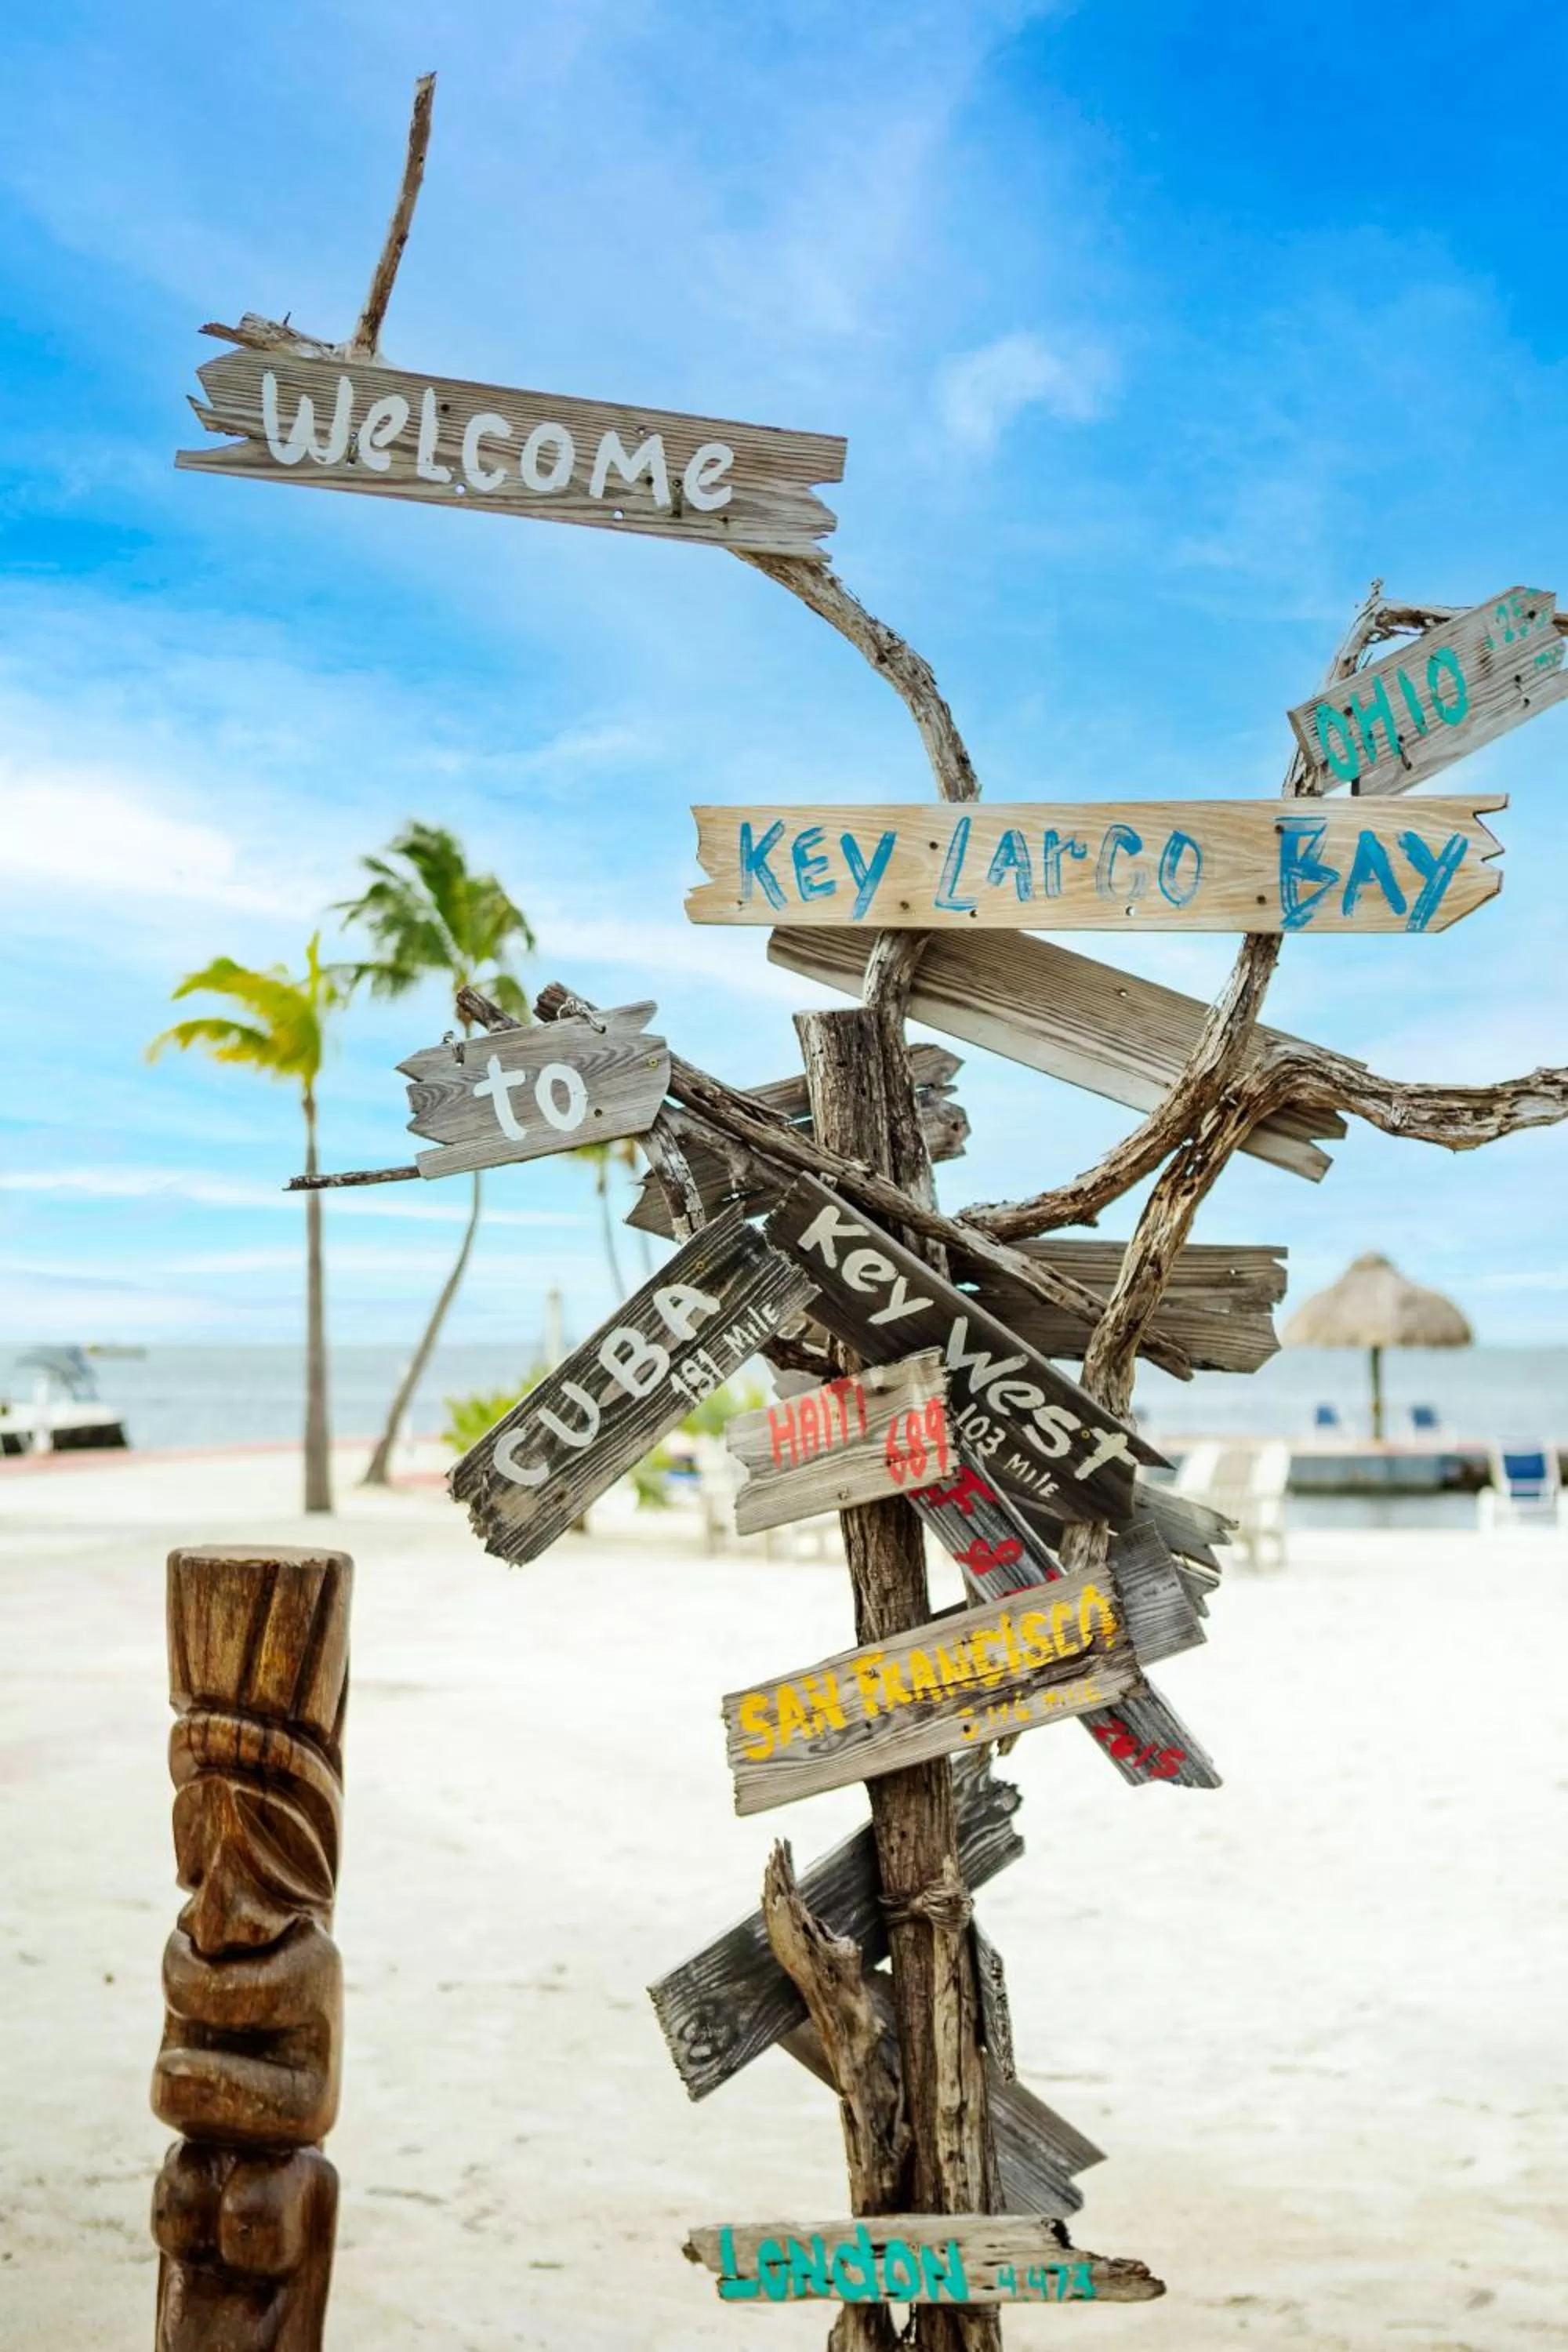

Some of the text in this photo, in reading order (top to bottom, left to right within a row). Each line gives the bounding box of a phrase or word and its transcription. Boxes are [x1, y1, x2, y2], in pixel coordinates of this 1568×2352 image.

[1314, 647, 1468, 781] OHIO
[740, 819, 896, 920] KEY
[1277, 816, 1469, 933] BAY
[493, 1283, 721, 1487] CUBA
[797, 1205, 1139, 1481] Key West
[768, 1377, 866, 1470] HAITI
[885, 1395, 949, 1486] 689
[956, 1403, 1007, 1457] 103
[739, 1583, 1119, 1761] SAN FRANCISCO
